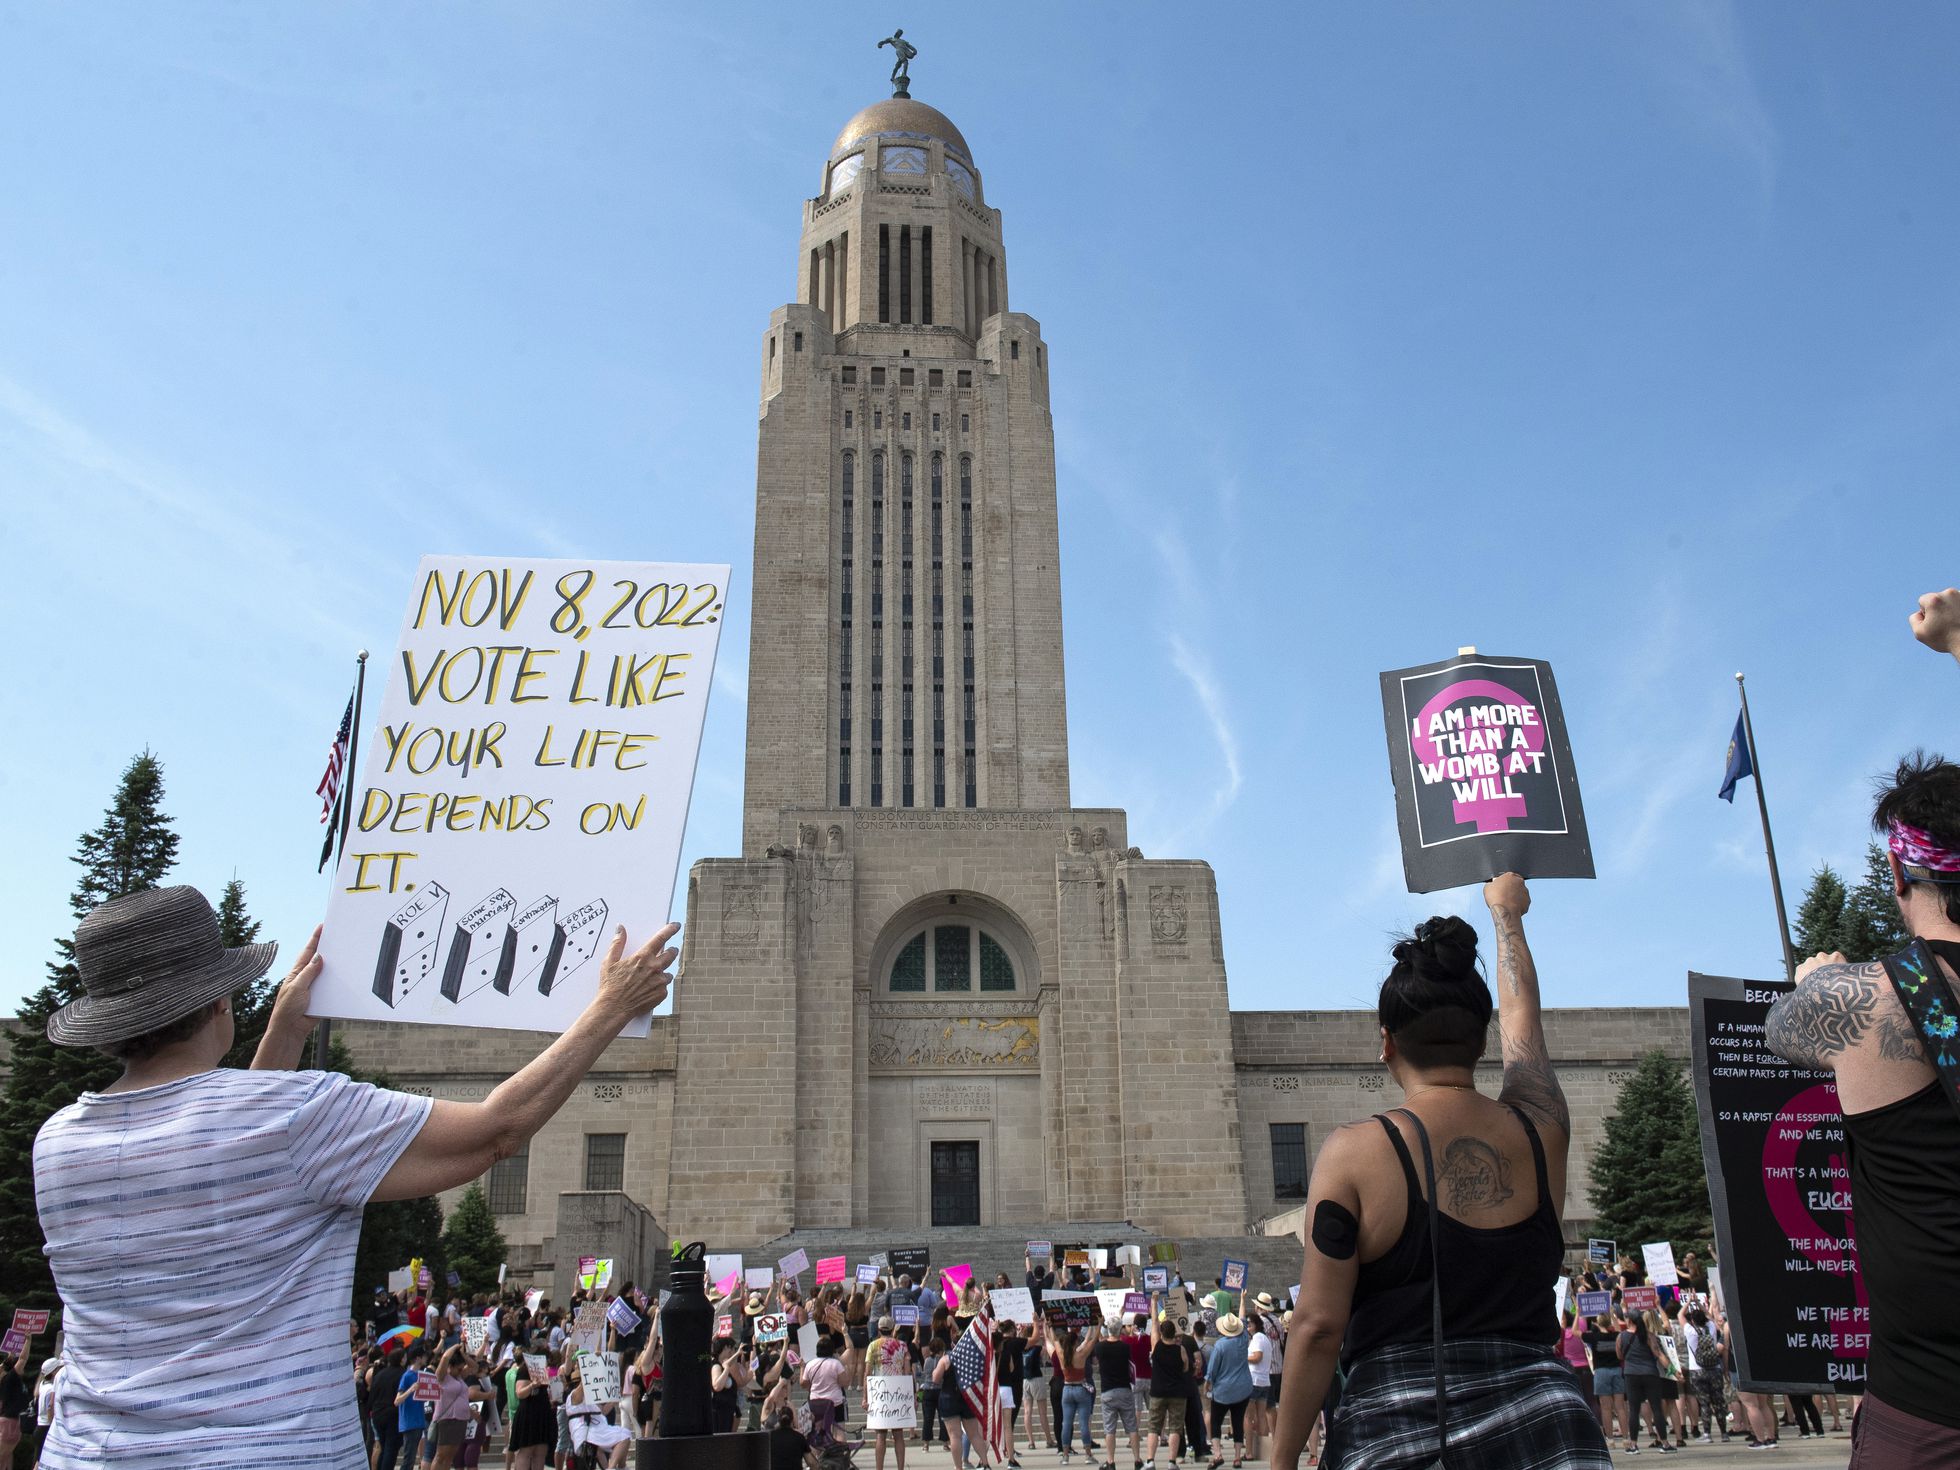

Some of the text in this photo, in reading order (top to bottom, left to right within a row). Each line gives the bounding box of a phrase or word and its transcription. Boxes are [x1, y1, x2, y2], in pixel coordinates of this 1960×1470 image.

[412, 568, 533, 632] NOV
[402, 646, 692, 709] VOTE LIKE
[1413, 704, 1539, 738] I AM MORE
[383, 721, 660, 779] YOUR LIFE
[1429, 728, 1530, 757] THAN A
[1418, 751, 1545, 785] WOMB AT
[1451, 776, 1522, 804] WILL
[358, 787, 648, 836] DEPENDS ON
[856, 812, 1053, 822] WISDOM JUSTICE POWER MERCY
[855, 822, 1054, 830] CONSTANT GUARDIANS OF THE LAW
[346, 852, 419, 894] IT.
[396, 886, 440, 926] ROE V
[560, 904, 594, 929] LGBTQ
[1745, 989, 1783, 1004] BECA
[1718, 1023, 1765, 1034] IF A HUMAN
[1709, 1038, 1740, 1048] OCCURS
[1742, 1039, 1754, 1048] AS
[1756, 1039, 1762, 1048] A
[1718, 1052, 1740, 1062] THEN
[1742, 1053, 1754, 1062] BE
[1713, 1068, 1748, 1078] CERTAIN
[1750, 1069, 1776, 1078] PARTS
[1778, 1070, 1790, 1078] OF
[1792, 1070, 1811, 1078] THIS
[1719, 1111, 1731, 1120] SO
[1734, 1112, 1740, 1122] A
[1742, 1112, 1773, 1122] RAPIST
[1775, 1113, 1794, 1122] CAN
[1780, 1129, 1804, 1141] AND
[1806, 1129, 1822, 1140] WE
[1765, 1167, 1805, 1179] THAT'S
[1808, 1168, 1817, 1179] A
[1788, 1238, 1857, 1252] THE MAJOR
[1785, 1259, 1858, 1273] WILL NEVER
[1796, 1306, 1818, 1320] WE
[1820, 1306, 1850, 1322] THE
[1786, 1333, 1872, 1350] WE ARE BET
